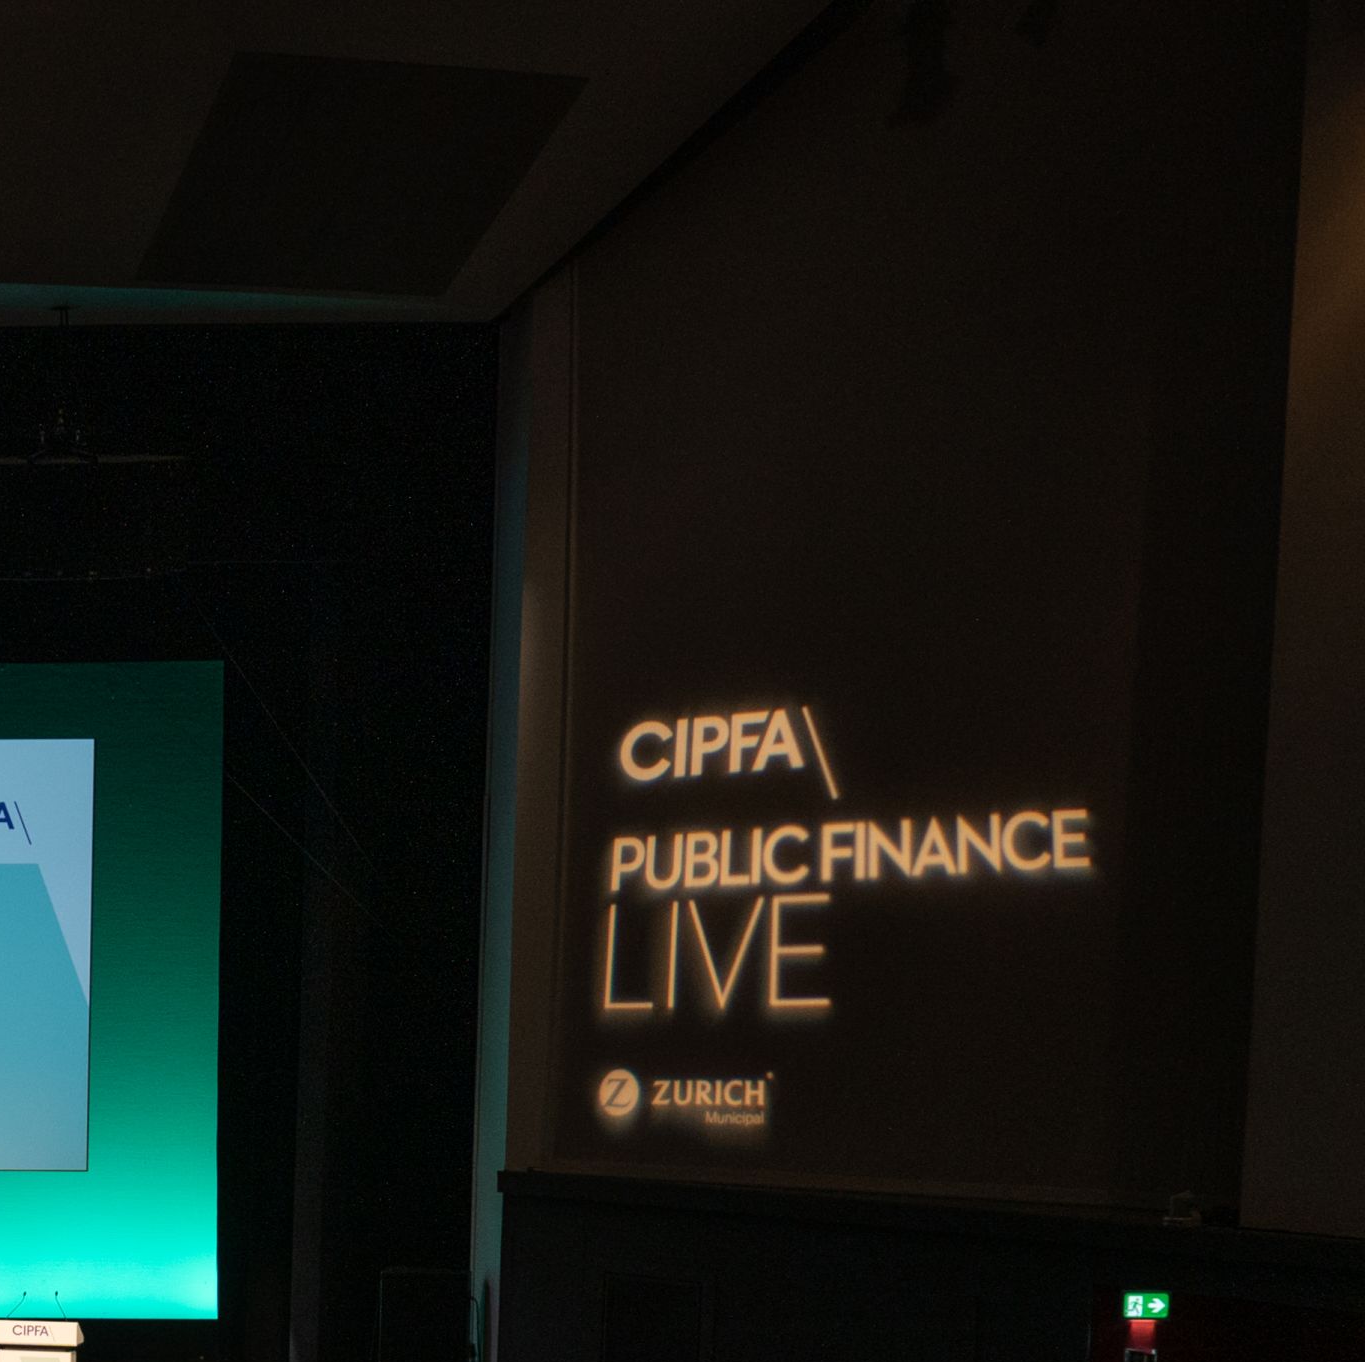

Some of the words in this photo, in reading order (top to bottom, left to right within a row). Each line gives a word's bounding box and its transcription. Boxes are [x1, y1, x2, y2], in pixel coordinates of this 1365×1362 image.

[610, 825, 809, 892] PUBLIC
[821, 808, 1092, 883] FINANCE
[604, 893, 832, 1009] LIVE
[651, 1077, 765, 1107] ZURICH
[705, 1110, 765, 1126] Municipal
